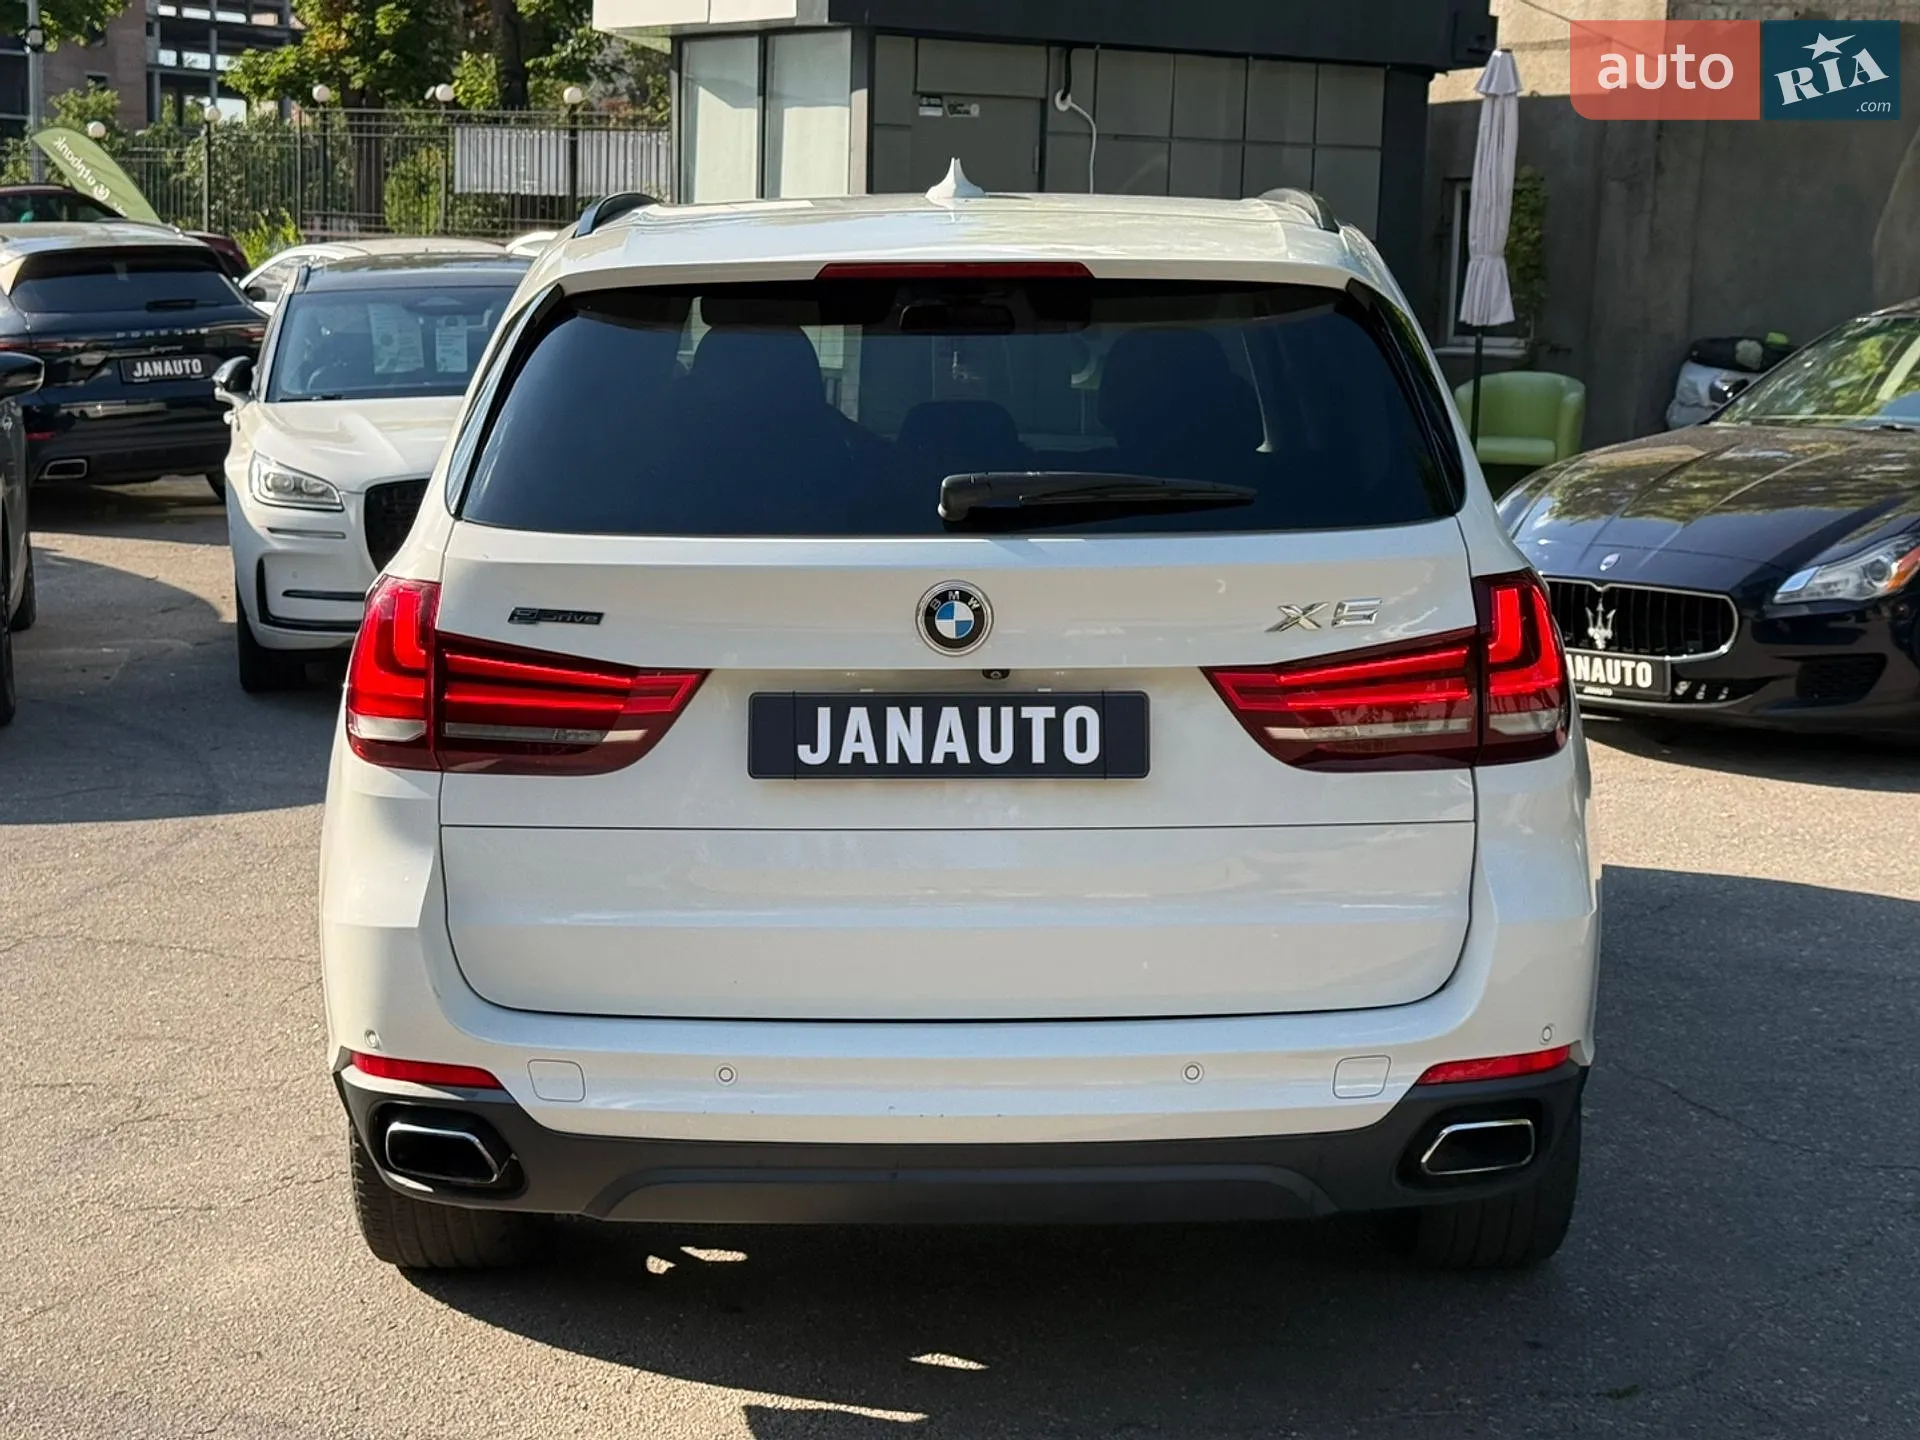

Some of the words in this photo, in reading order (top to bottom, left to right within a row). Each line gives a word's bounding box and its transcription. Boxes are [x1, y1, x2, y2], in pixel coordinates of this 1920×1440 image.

[132, 358, 203, 377] JANAUTO
[929, 590, 980, 611] BMW
[1264, 598, 1382, 632] X5
[1565, 653, 1652, 688] ANAUTO
[797, 705, 1100, 766] JANAUTO
